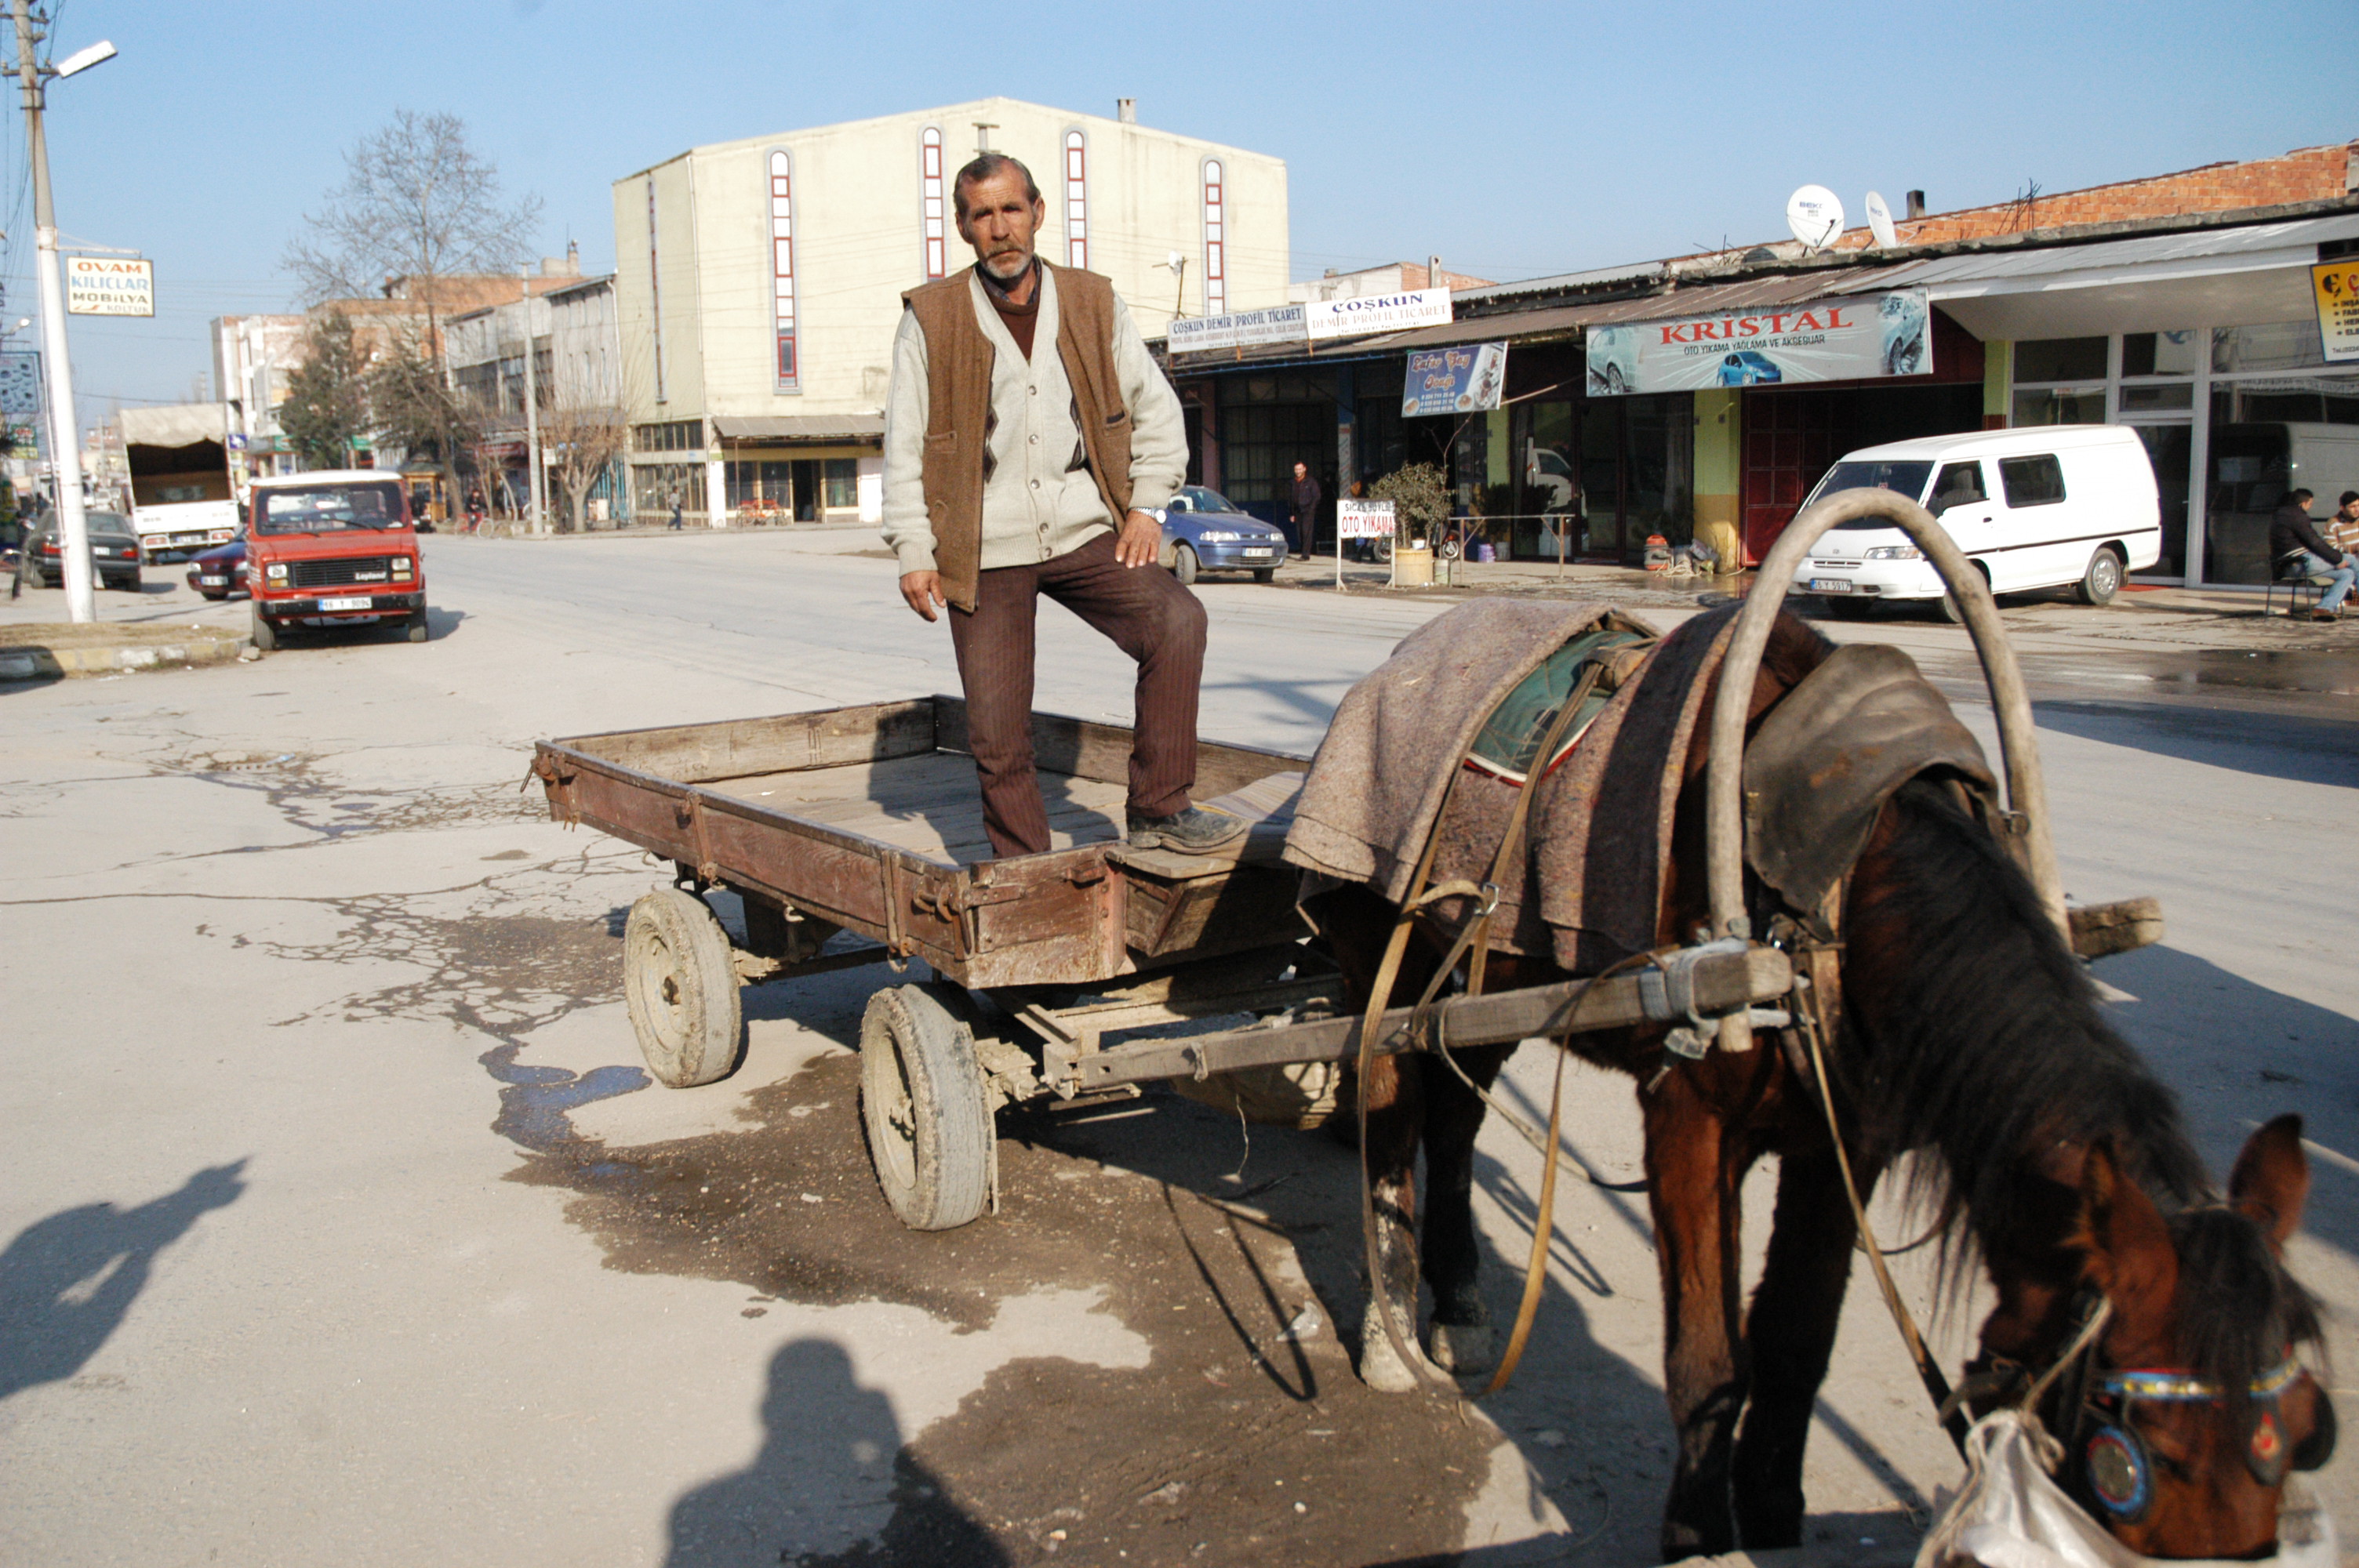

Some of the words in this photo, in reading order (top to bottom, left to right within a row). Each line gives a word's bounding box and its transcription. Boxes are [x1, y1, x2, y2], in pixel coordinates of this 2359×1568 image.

[77, 262, 142, 274] OVAM
[107, 305, 150, 314] KOLTUK
[1173, 321, 1205, 334] COŞKUN
[1207, 316, 1232, 330] DEMİR
[1236, 311, 1265, 326] PROFİL
[1267, 308, 1301, 322] TİCARET
[1660, 308, 1853, 345] KRİSTAL
[1684, 345, 1699, 356] OTO
[1769, 338, 1779, 347] VE
[1342, 516, 1360, 533] OTO
[1362, 515, 1394, 534] YIKAMA
[354, 571, 387, 581] Leyland
